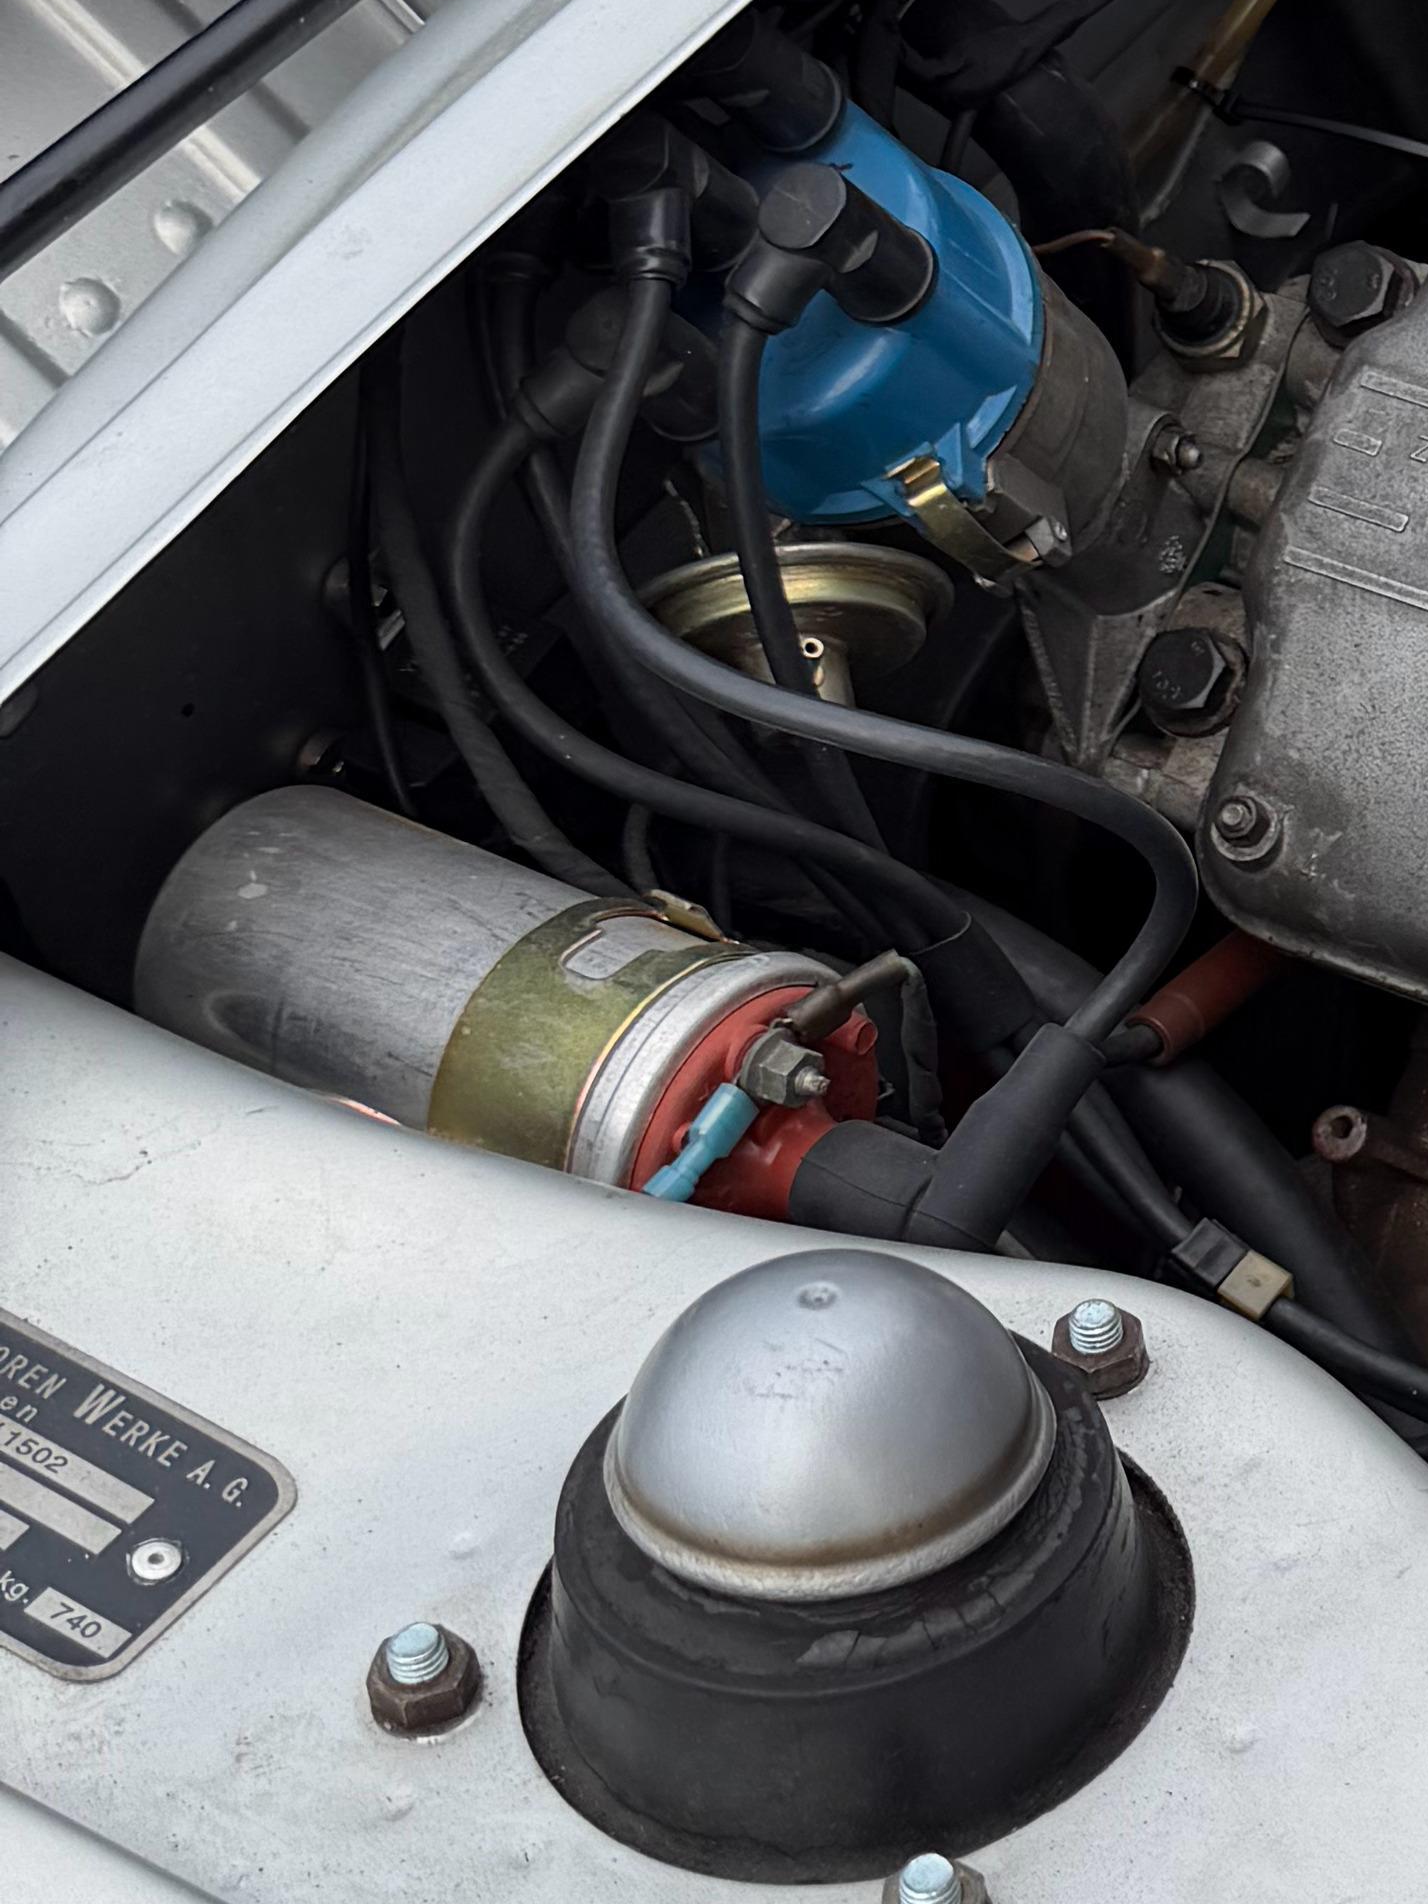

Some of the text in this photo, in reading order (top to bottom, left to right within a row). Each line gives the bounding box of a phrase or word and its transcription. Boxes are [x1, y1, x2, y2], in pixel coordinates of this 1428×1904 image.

[73, 1383, 189, 1468] WERKE
[4, 1430, 68, 1474] 1502
[50, 1601, 102, 1638] 740
